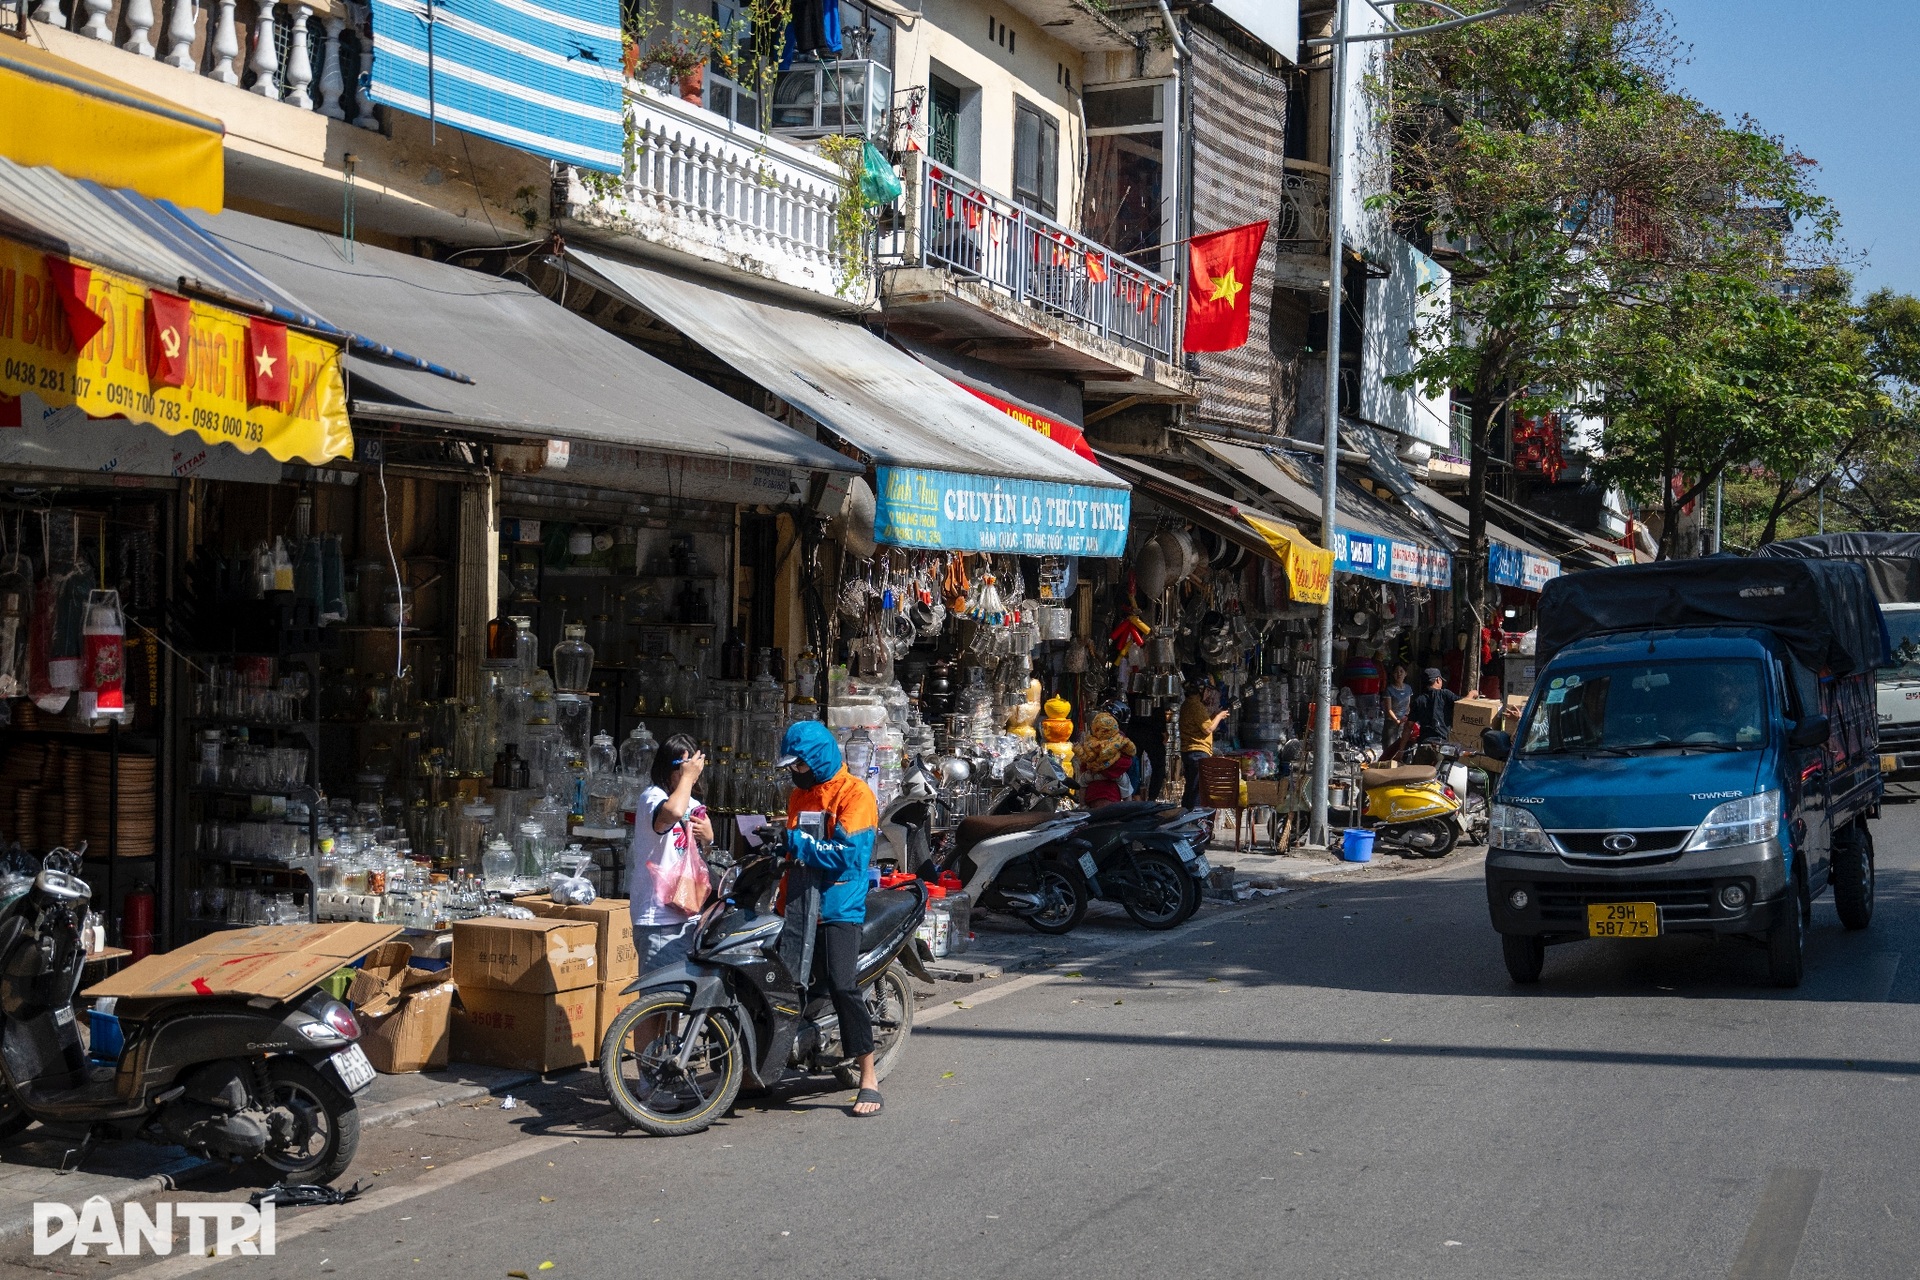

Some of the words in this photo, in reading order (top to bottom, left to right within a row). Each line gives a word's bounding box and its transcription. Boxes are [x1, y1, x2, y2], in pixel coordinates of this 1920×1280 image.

[6, 357, 36, 385] 0438
[40, 367, 65, 393] 281
[72, 374, 91, 398] 107
[107, 382, 133, 406] 0979
[137, 392, 155, 415] 700
[159, 399, 181, 422] 783
[192, 408, 219, 432] 0983
[222, 415, 242, 437] 000
[245, 421, 264, 442] 783
[943, 484, 1017, 524] CHUYÊN
[1022, 495, 1042, 533] LỌ
[1045, 486, 1088, 529] THỦY
[1090, 502, 1125, 532] TINH
[1510, 796, 1545, 804] THACO
[1689, 790, 1743, 801] TOWNER
[1607, 905, 1636, 919] 29H
